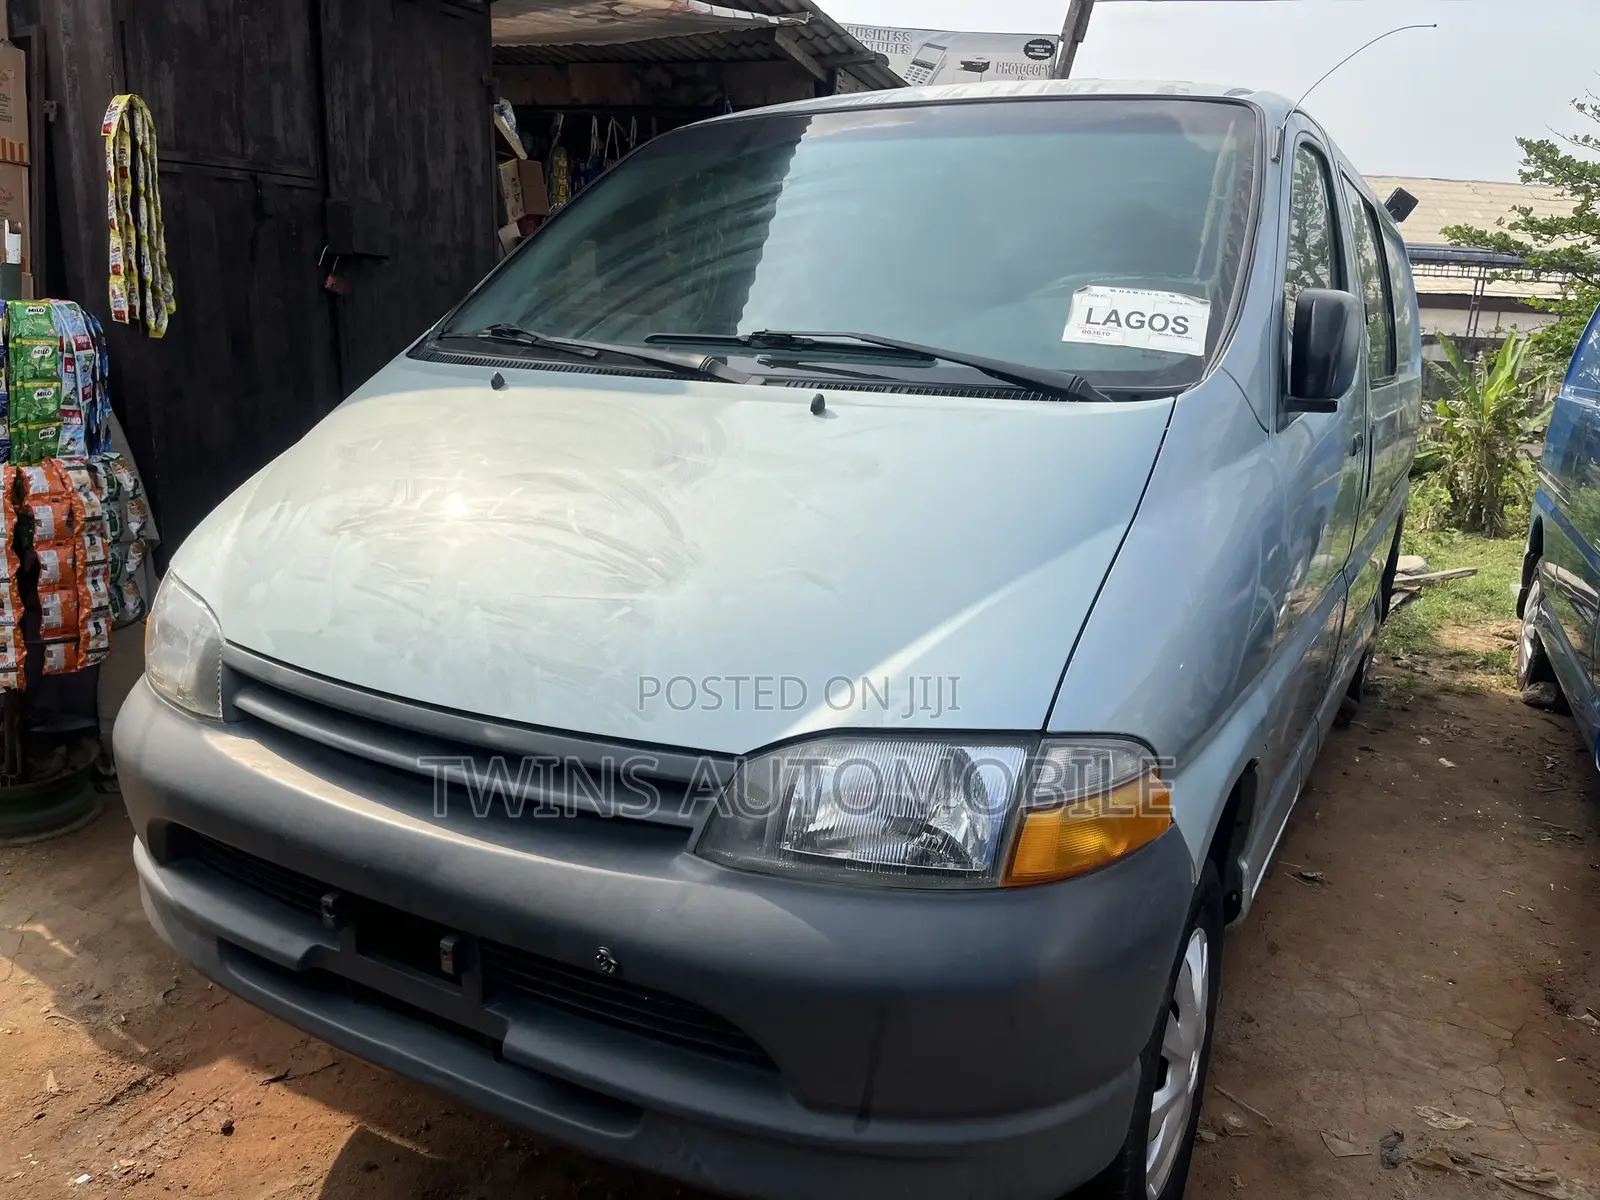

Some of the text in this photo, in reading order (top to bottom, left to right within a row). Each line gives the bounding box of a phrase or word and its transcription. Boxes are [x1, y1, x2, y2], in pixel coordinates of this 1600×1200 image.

[847, 27, 912, 43] BUSINESS
[861, 40, 911, 54] NTURES
[1085, 308, 1189, 335] LAGOS
[40, 430, 55, 438] MILO
